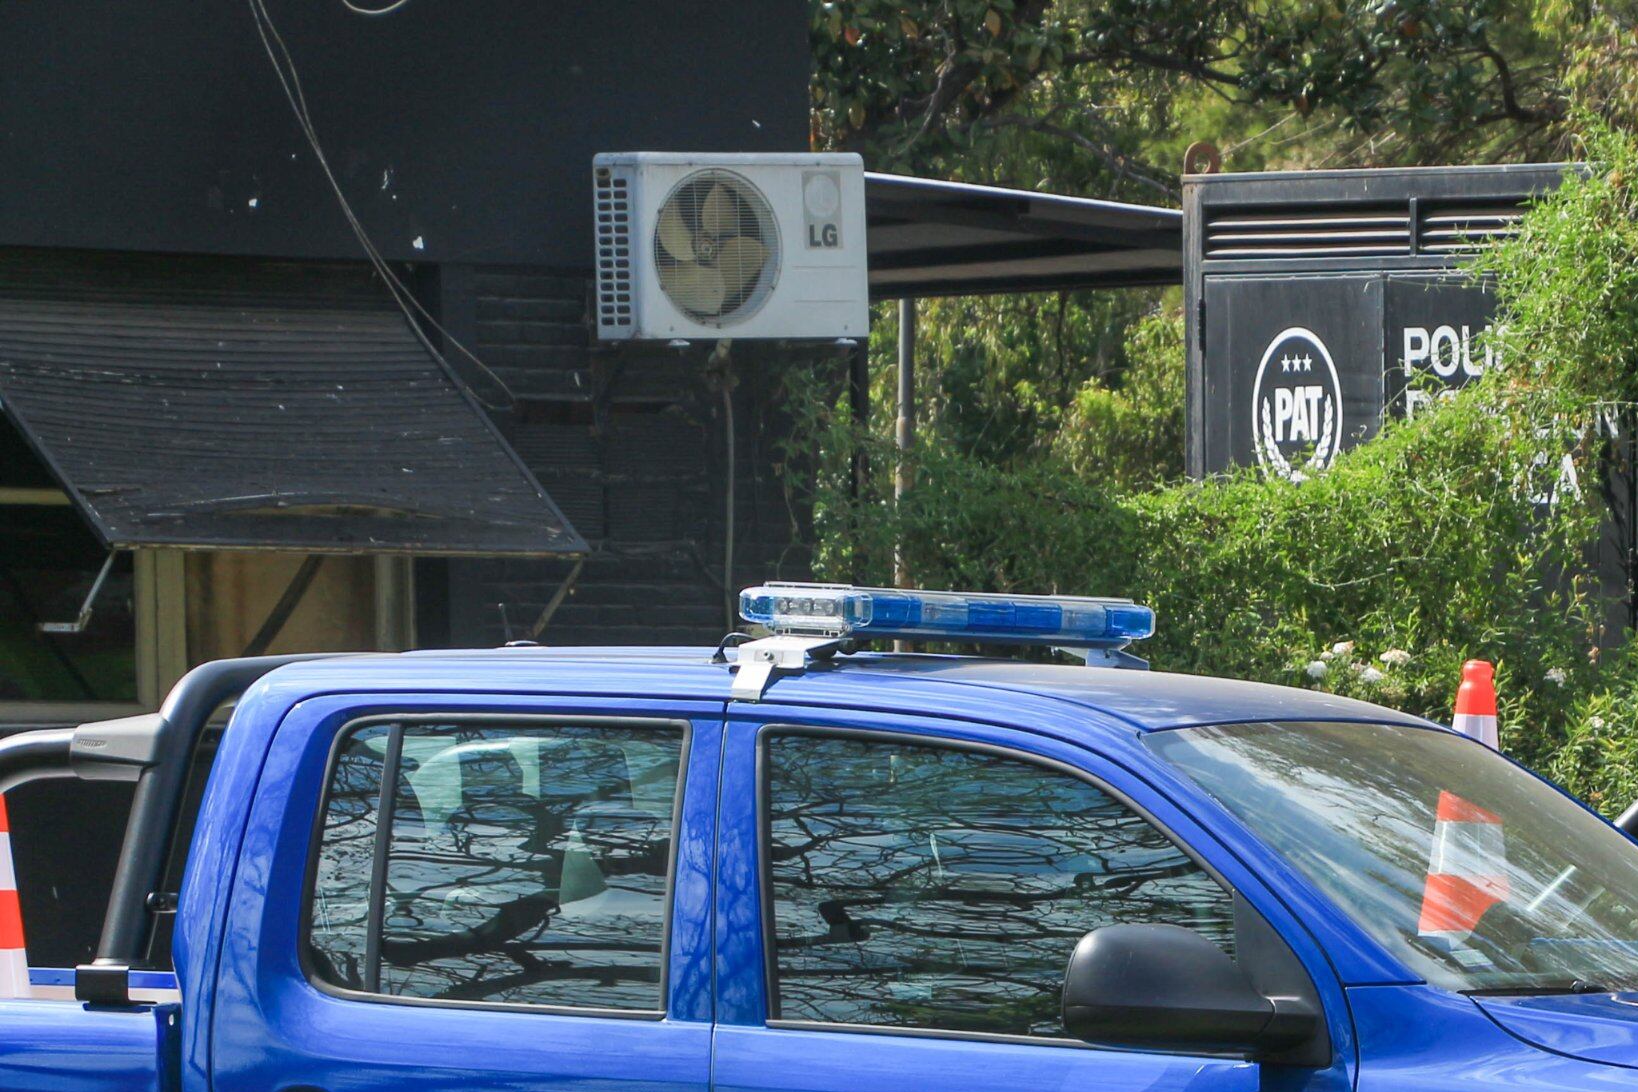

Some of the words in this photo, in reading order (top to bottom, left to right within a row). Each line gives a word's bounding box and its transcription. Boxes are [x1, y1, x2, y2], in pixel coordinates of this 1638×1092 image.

[808, 224, 838, 248] LG
[1403, 325, 1510, 377] POLI
[1274, 385, 1324, 443] PAT
